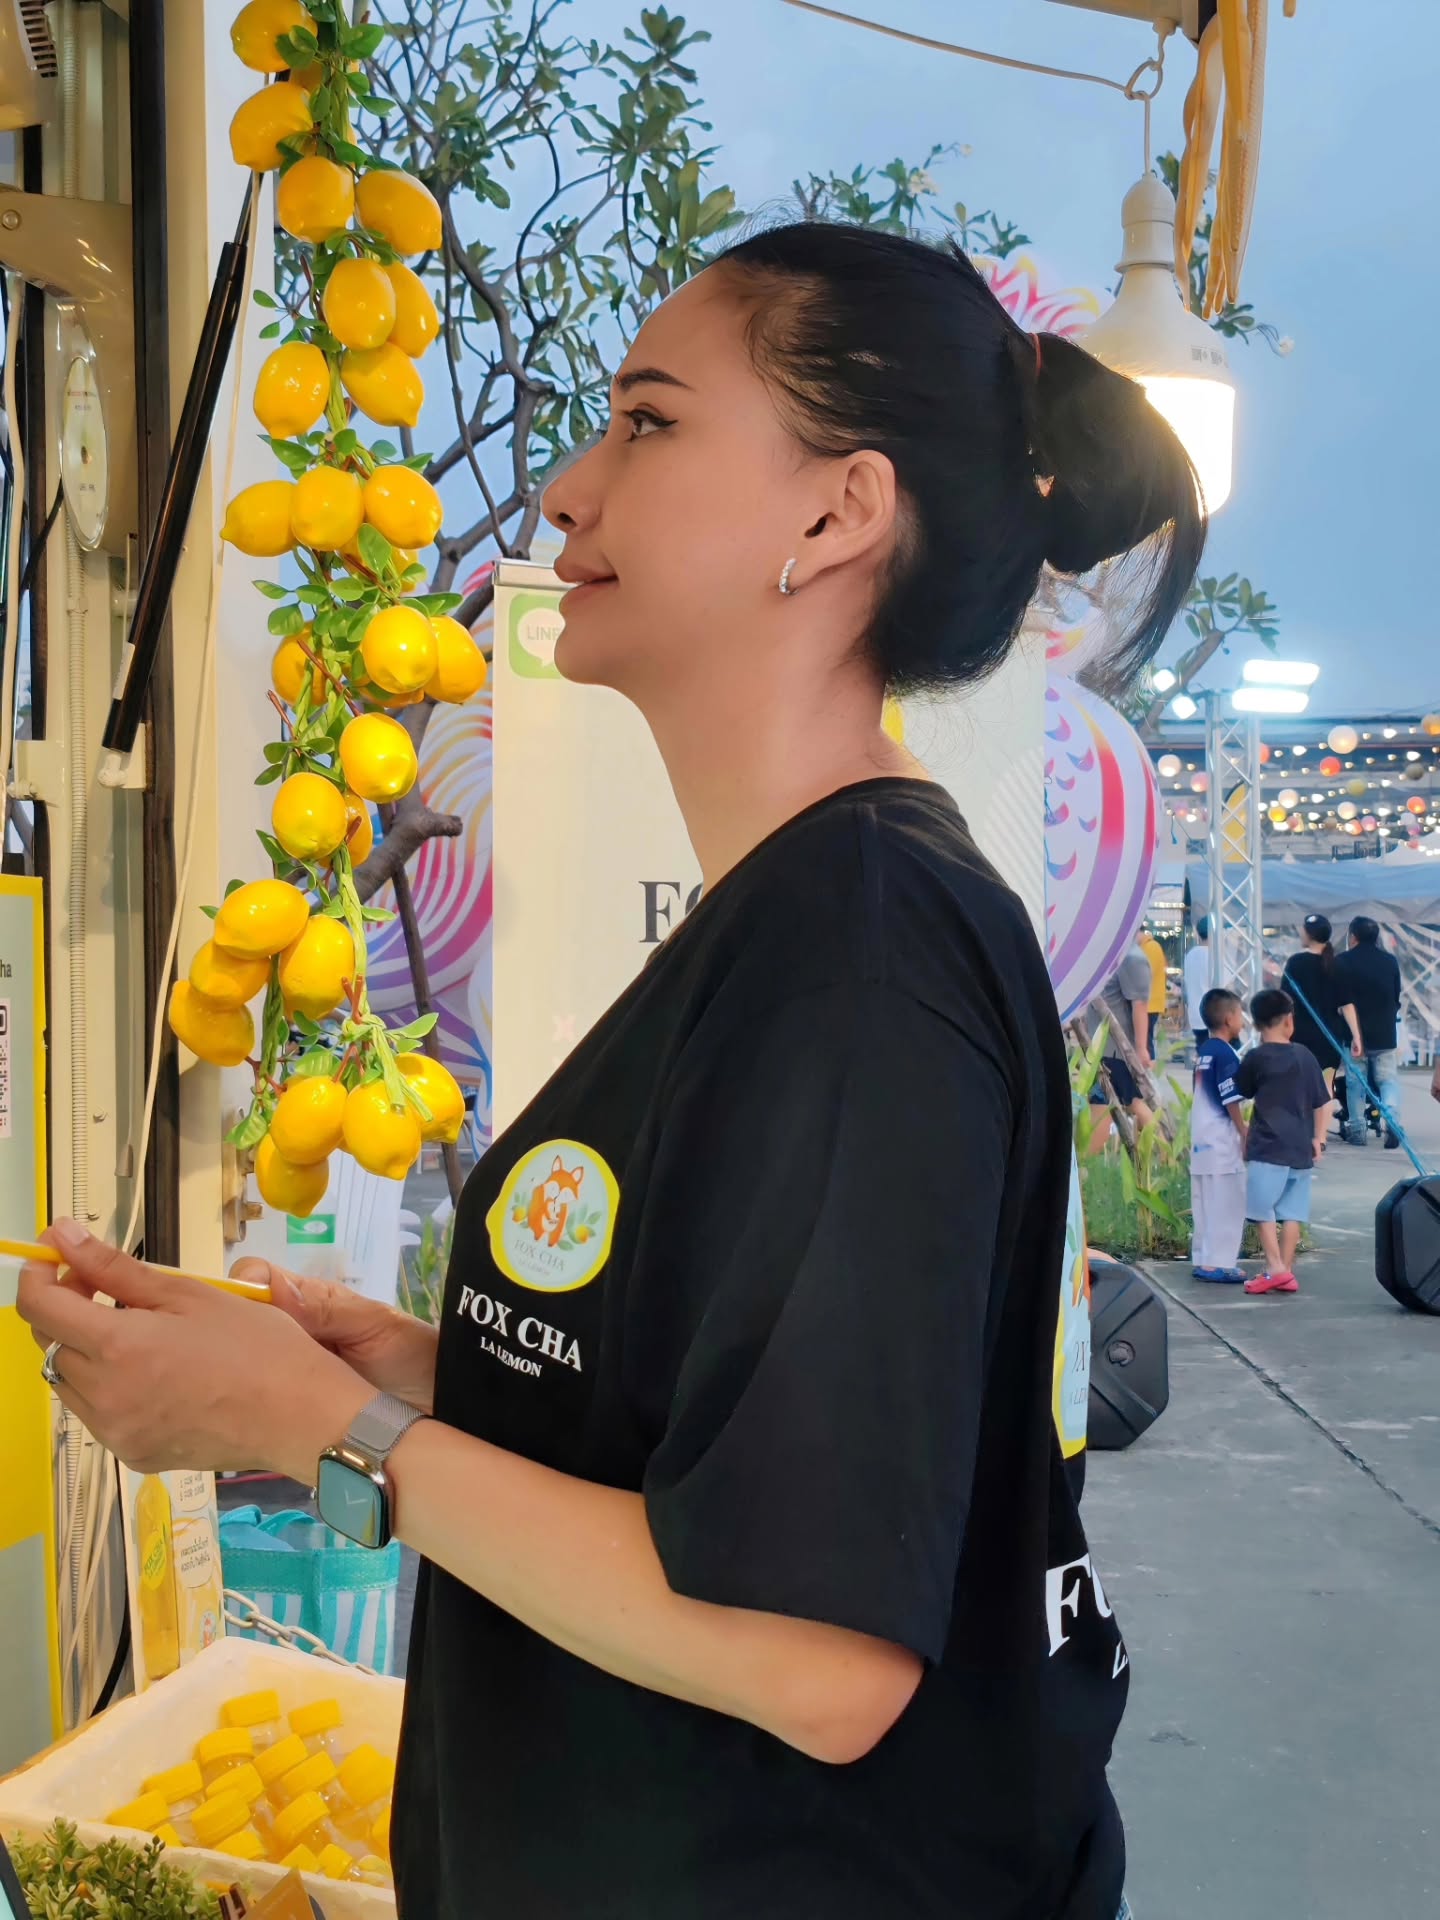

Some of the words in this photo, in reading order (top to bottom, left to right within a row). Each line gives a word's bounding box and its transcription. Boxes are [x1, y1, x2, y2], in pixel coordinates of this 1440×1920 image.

[457, 1284, 512, 1337] FOX
[517, 1316, 582, 1372] CHA
[480, 1336, 496, 1355] LA
[497, 1345, 542, 1378] LEMON
